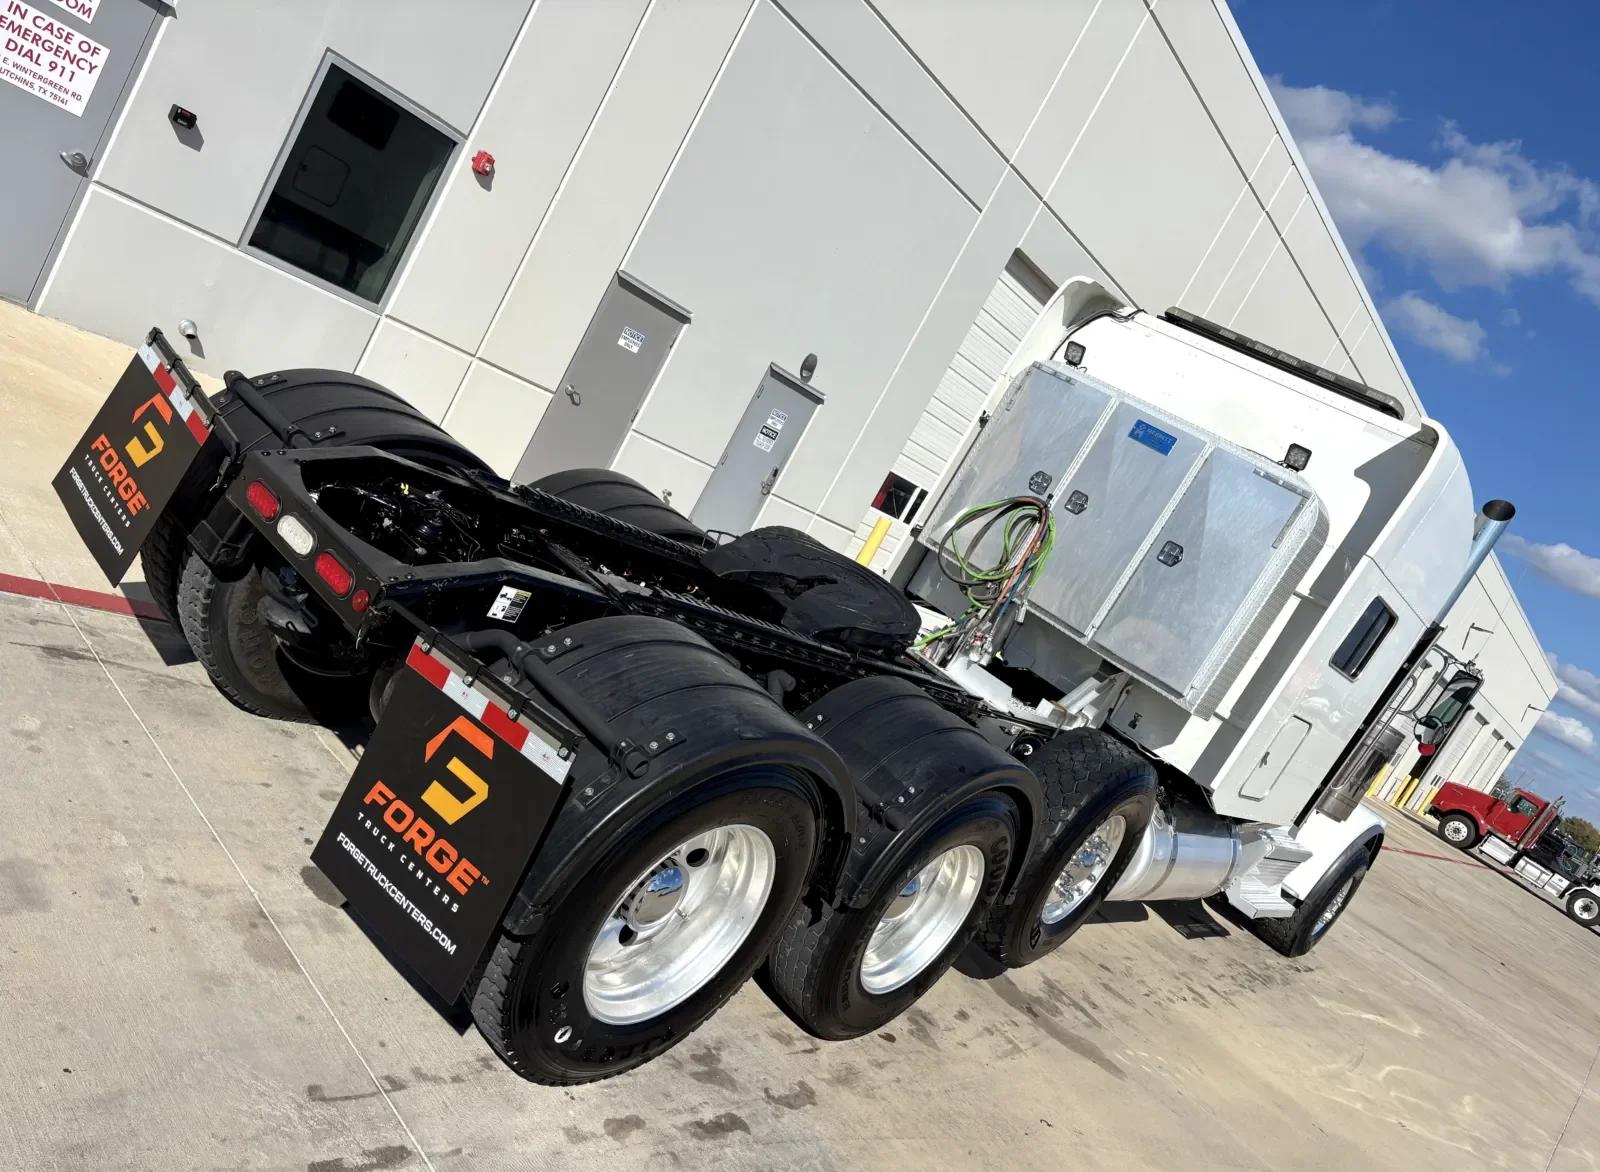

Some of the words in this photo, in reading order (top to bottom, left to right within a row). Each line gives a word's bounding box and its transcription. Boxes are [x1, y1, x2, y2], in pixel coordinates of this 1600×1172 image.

[0, 15, 98, 75] EMERGENCY
[5, 38, 42, 66] DIAL
[48, 60, 76, 82] 911
[7, 1, 28, 20] IN
[32, 15, 75, 45] CASE
[78, 40, 101, 58] OF
[12, 61, 70, 95] WINTERGREEN
[70, 90, 83, 102] RD.
[38, 86, 47, 96] TX
[49, 91, 69, 106] 75141
[69, 466, 125, 556] FORGETRUCKCENTERS.COM
[84, 453, 102, 485] TRUCK
[103, 484, 131, 529] CENTERS
[90, 433, 146, 517] FORGE
[357, 812, 395, 852] TRUCK
[400, 853, 461, 914] CENTERS
[363, 780, 482, 897] FORGE
[336, 831, 457, 956] FORGETRUCKCENTERS.COM
